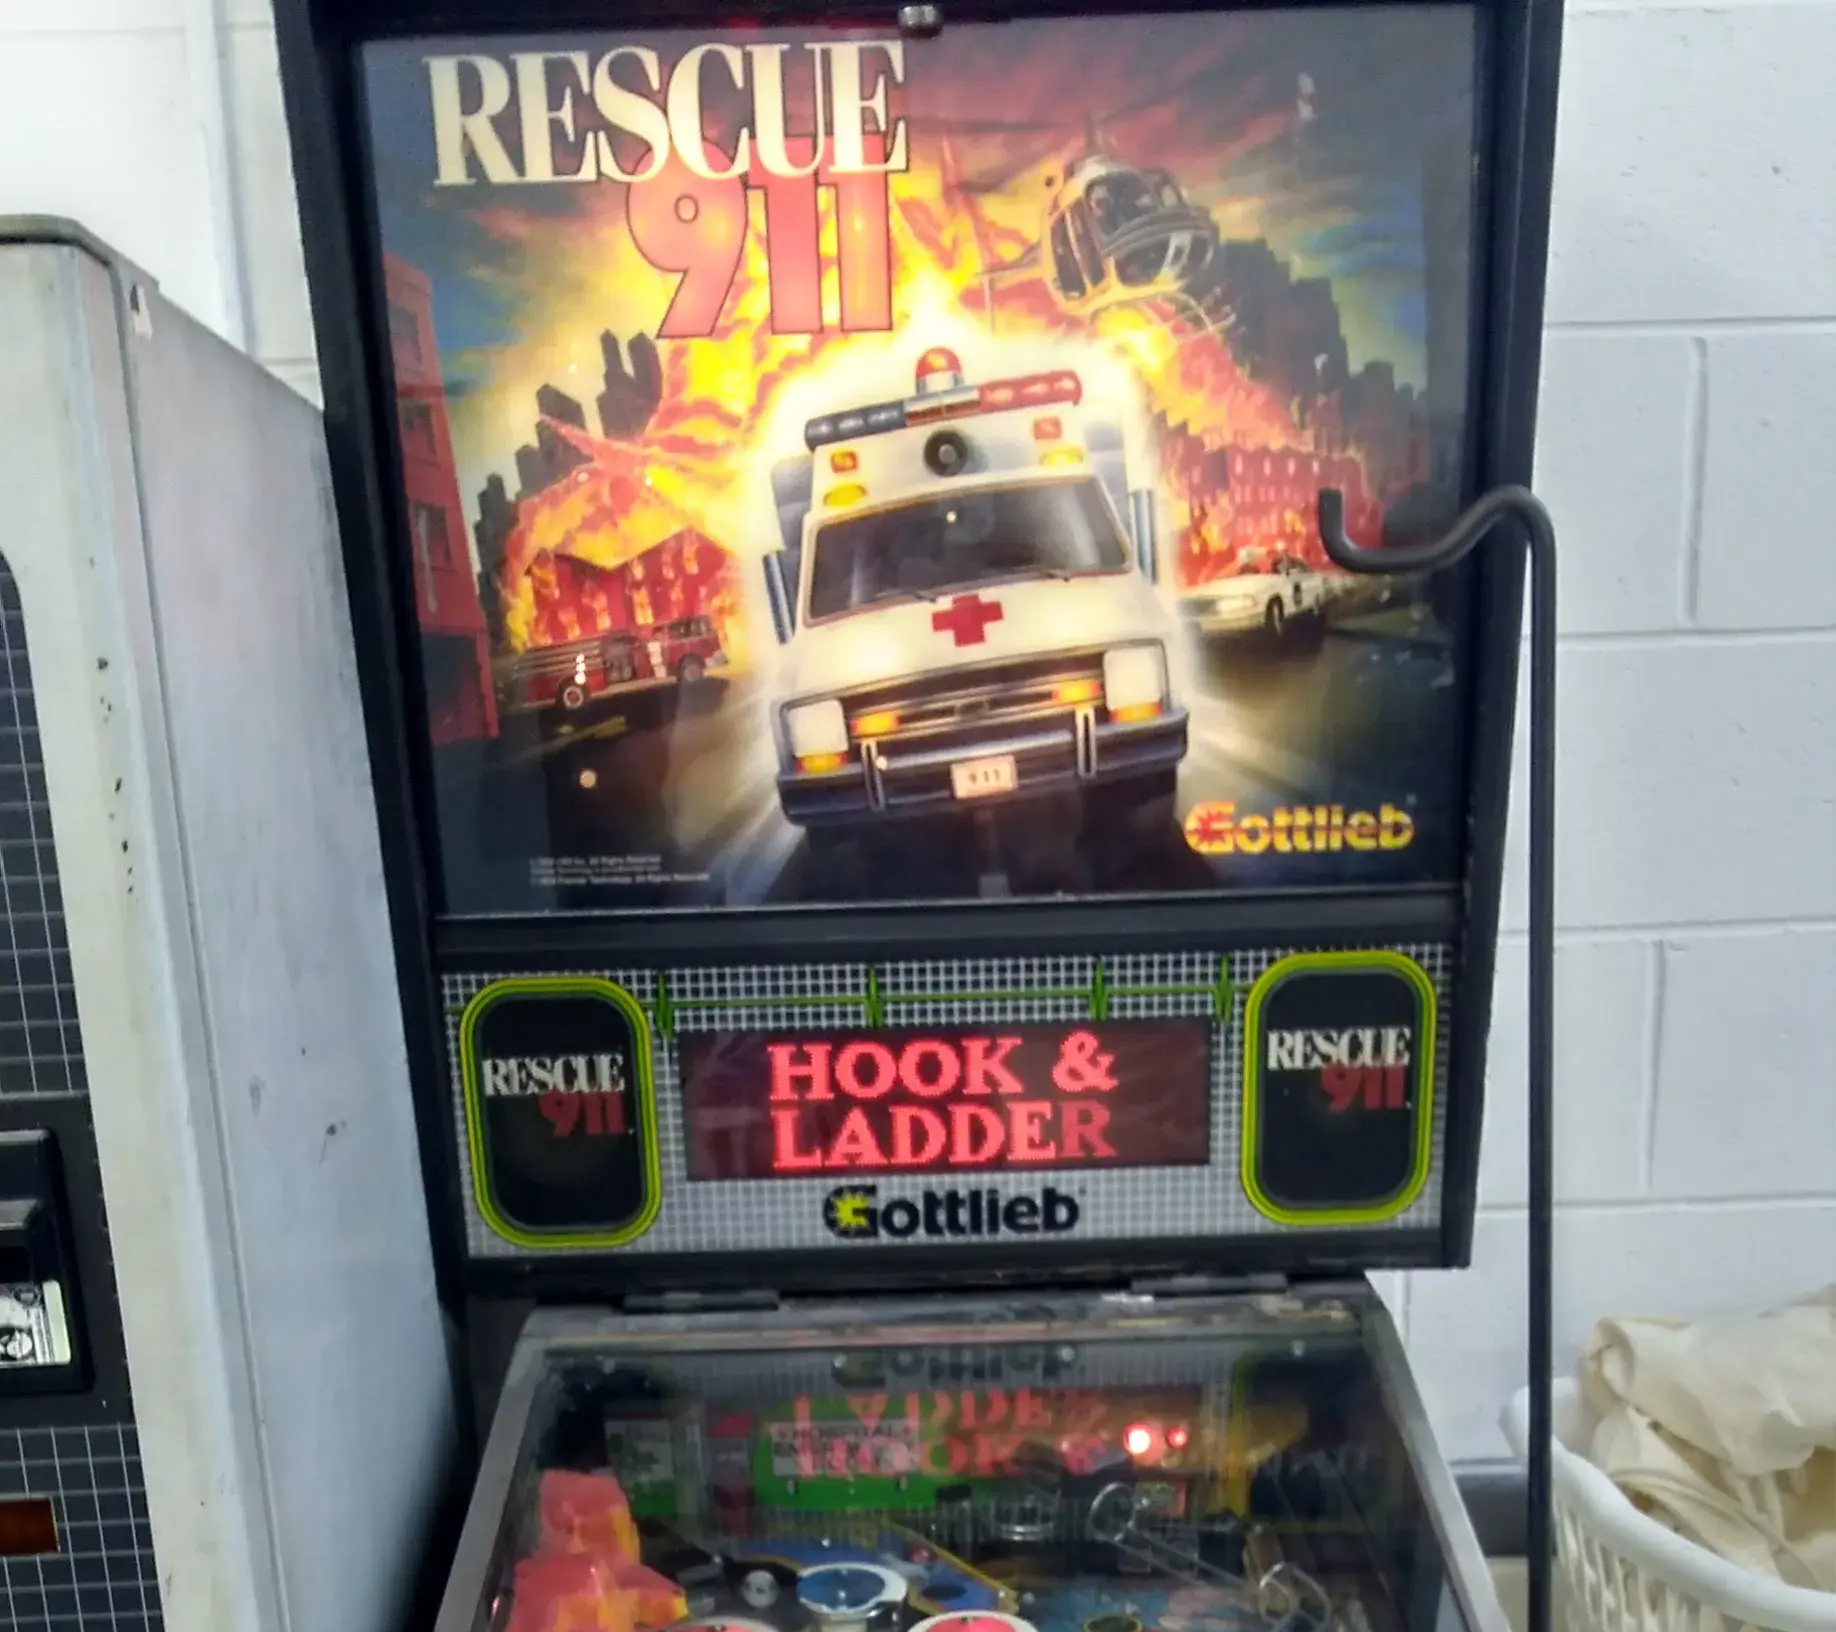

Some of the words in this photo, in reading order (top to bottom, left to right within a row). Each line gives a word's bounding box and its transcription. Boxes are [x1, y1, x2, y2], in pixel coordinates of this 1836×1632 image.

[423, 40, 909, 186] RESCUE
[625, 136, 895, 339] 911
[1184, 801, 1415, 855] Gottlieb
[482, 1053, 625, 1096] RESCUE
[768, 1034, 1023, 1100] HOOK
[1052, 1031, 1119, 1093] &
[1267, 1026, 1411, 1070] RESCUE
[1320, 1064, 1406, 1110] 911
[539, 1091, 626, 1138] 911
[770, 1100, 1116, 1169] LADDER
[823, 1185, 1080, 1238] Gottlieb
